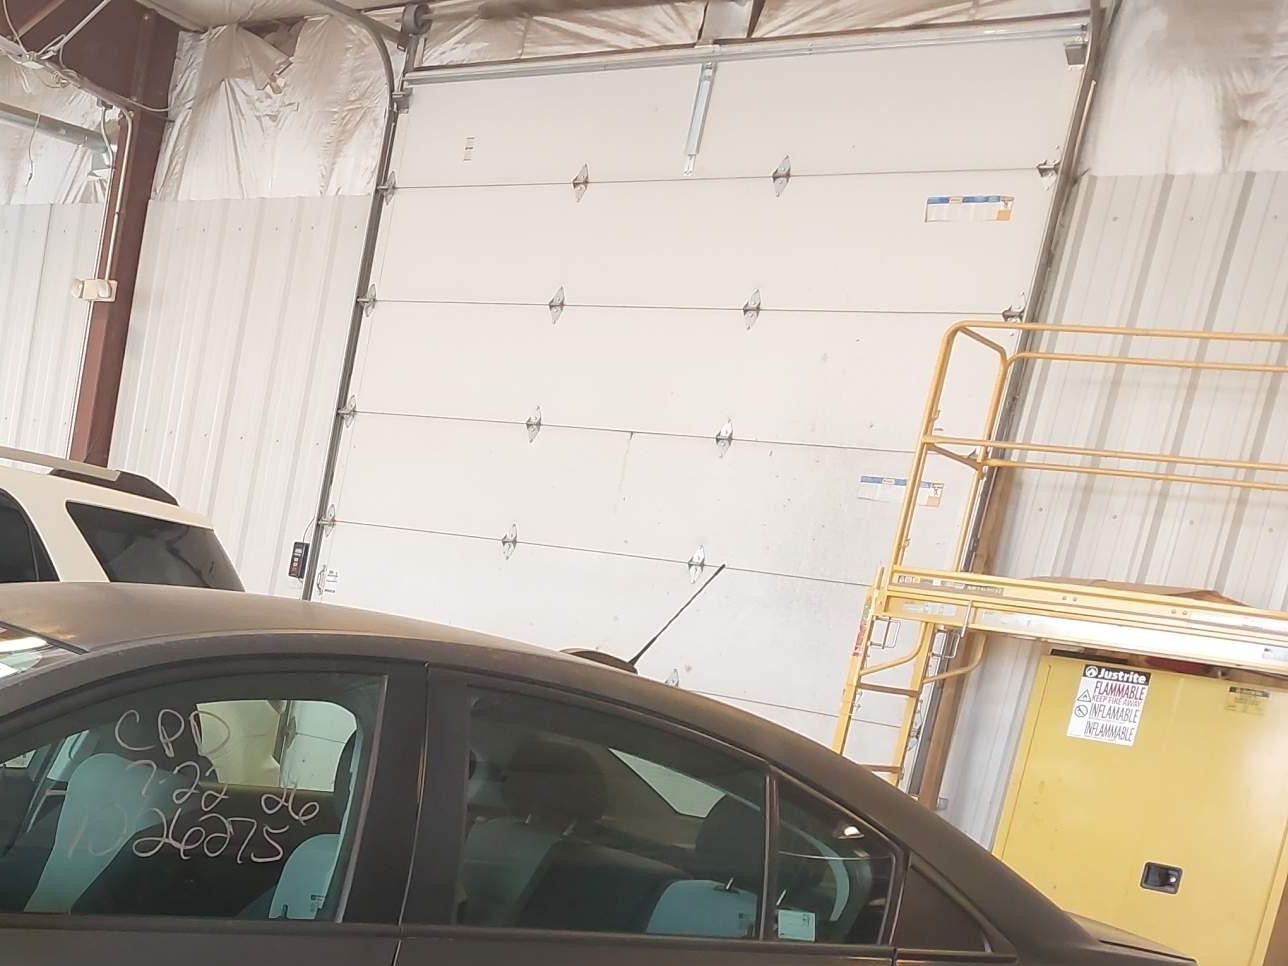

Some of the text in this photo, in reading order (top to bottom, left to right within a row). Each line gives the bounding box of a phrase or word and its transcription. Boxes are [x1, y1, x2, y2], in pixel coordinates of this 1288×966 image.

[1098, 668, 1146, 684] Justrite
[1091, 694, 1107, 703] KEEP
[1093, 680, 1146, 701] FLAMMABLE
[1088, 702, 1139, 723] INFLAMABLE
[114, 708, 231, 759] CPD
[1083, 720, 1135, 742] INFLAMMABLE
[132, 807, 290, 864] 26275
